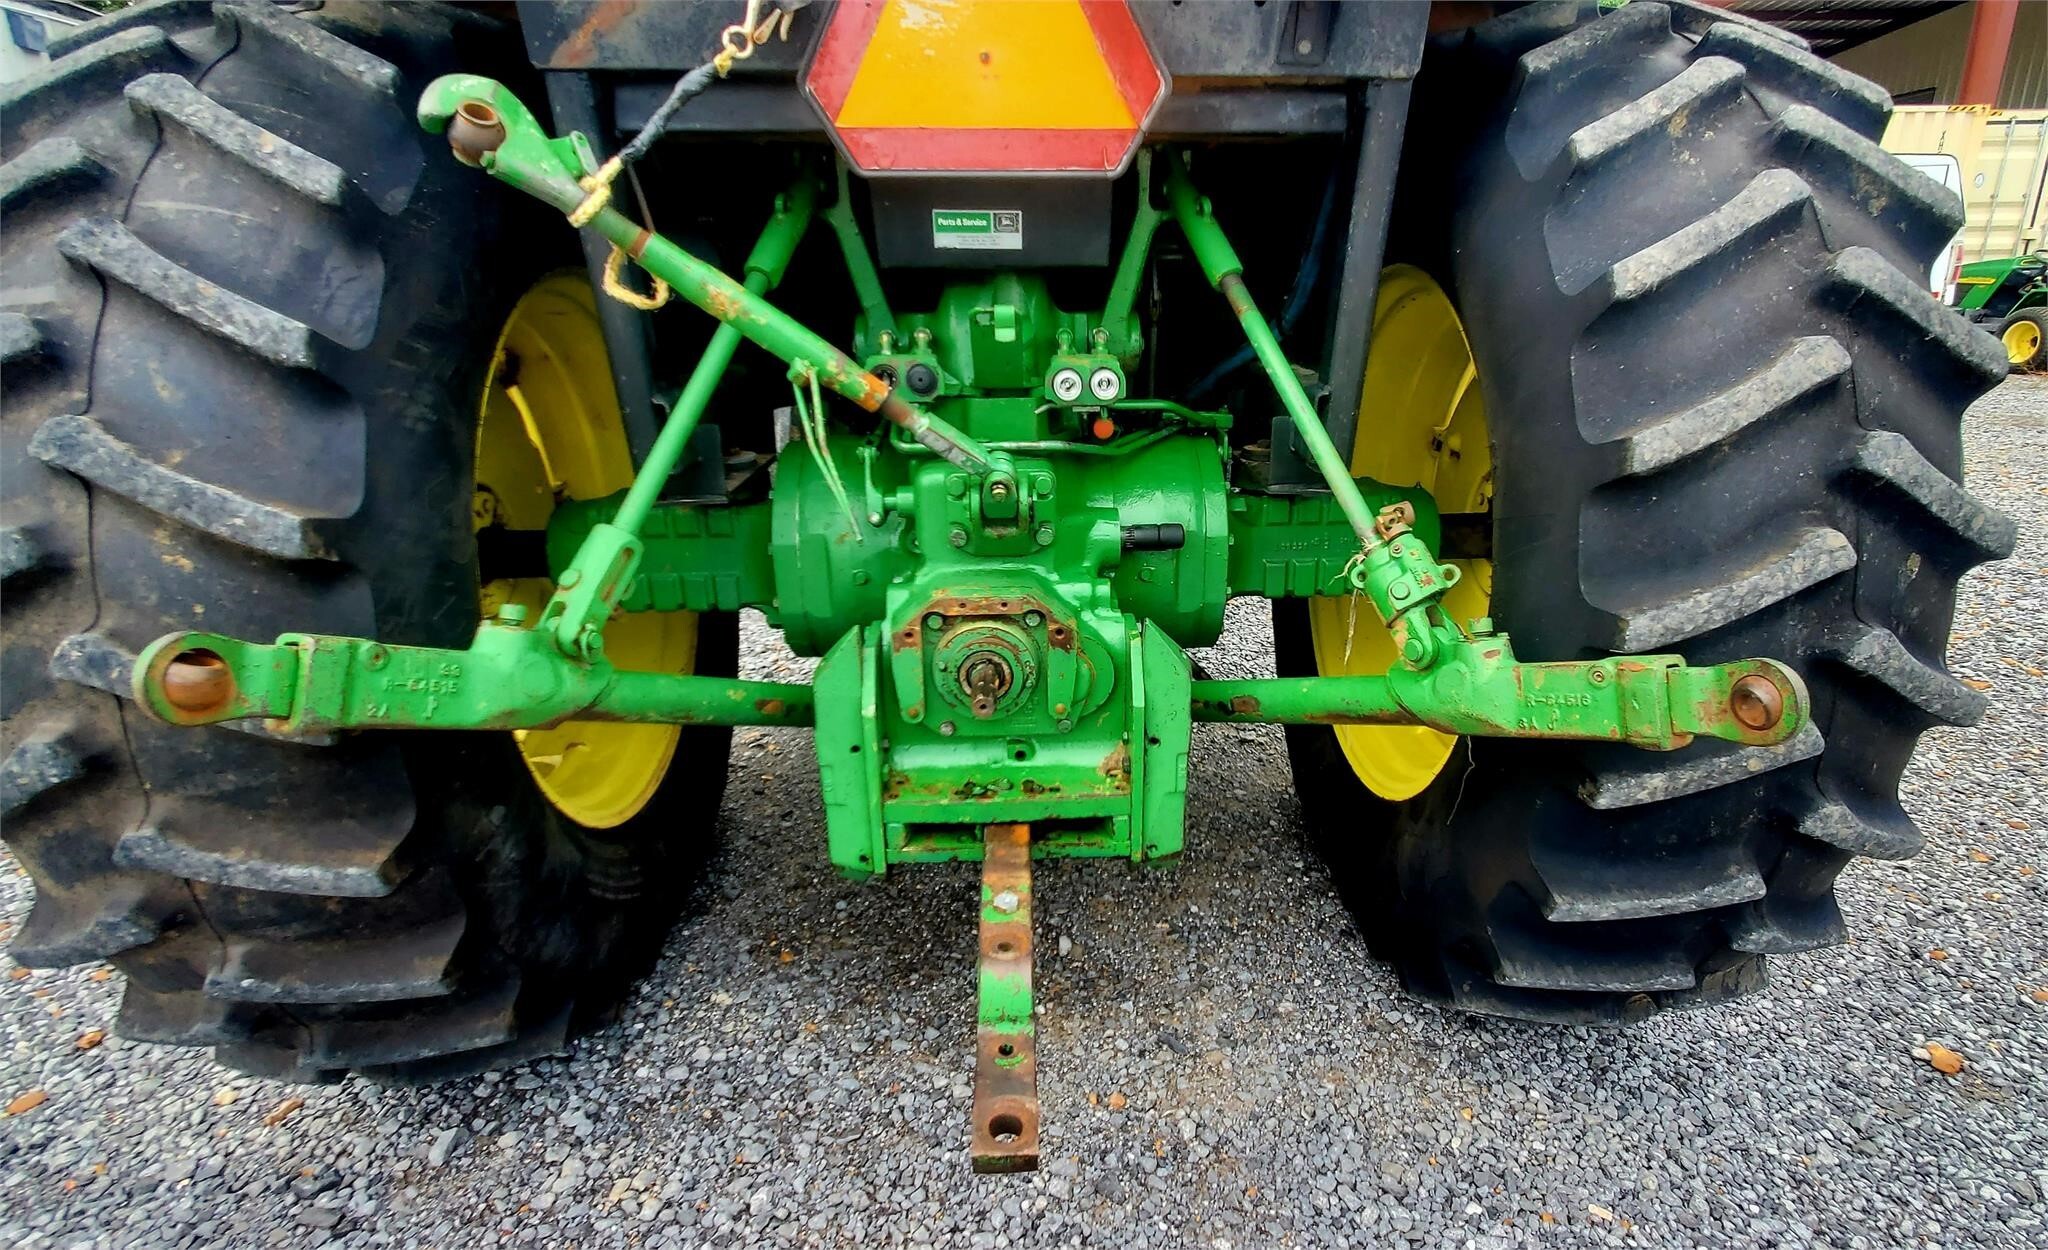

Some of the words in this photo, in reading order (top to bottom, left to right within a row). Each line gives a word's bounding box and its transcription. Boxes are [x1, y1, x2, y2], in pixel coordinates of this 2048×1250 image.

[937, 217, 956, 226] Parts
[956, 218, 962, 226] &
[962, 218, 988, 227] Service
